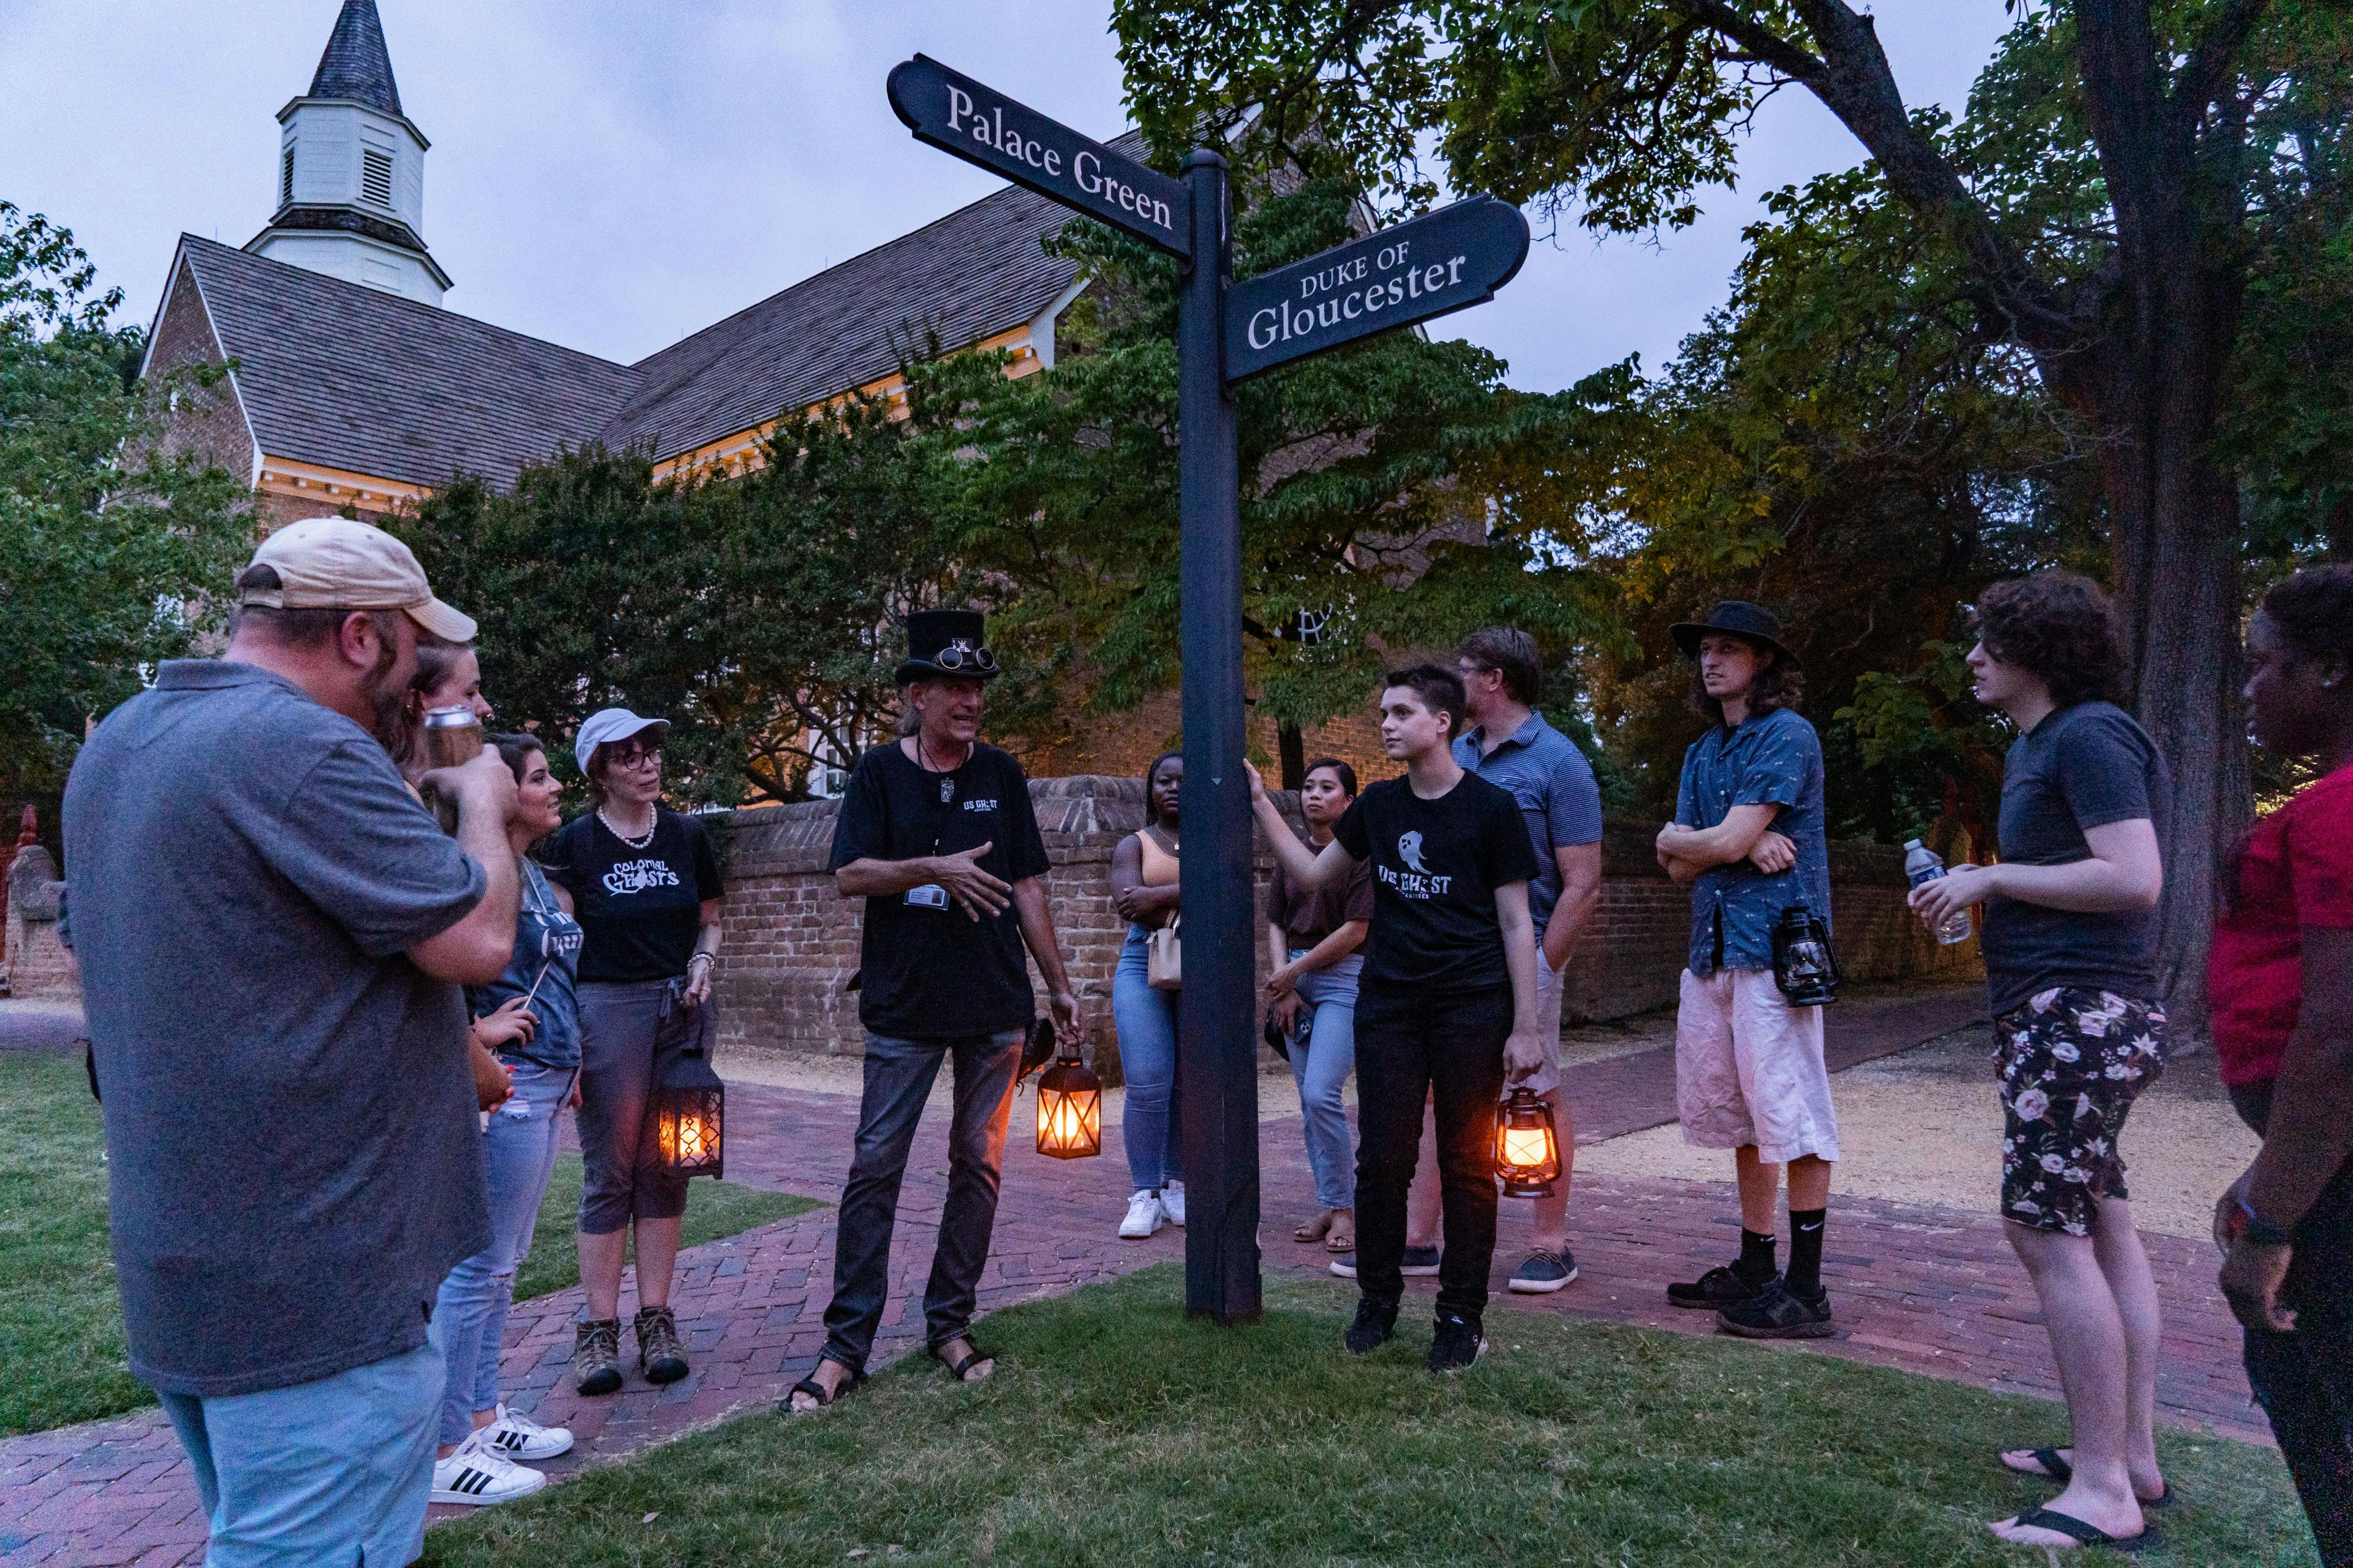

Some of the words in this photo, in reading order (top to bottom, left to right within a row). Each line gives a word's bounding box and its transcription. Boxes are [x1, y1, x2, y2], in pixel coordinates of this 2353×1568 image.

[947, 84, 1061, 176] Palace
[1074, 150, 1172, 230] Green
[1301, 256, 1368, 299] DUKE
[1377, 241, 1409, 270] OF
[1248, 255, 1465, 349] Gloucester
[963, 801, 974, 810] US
[1378, 865, 1397, 885] US
